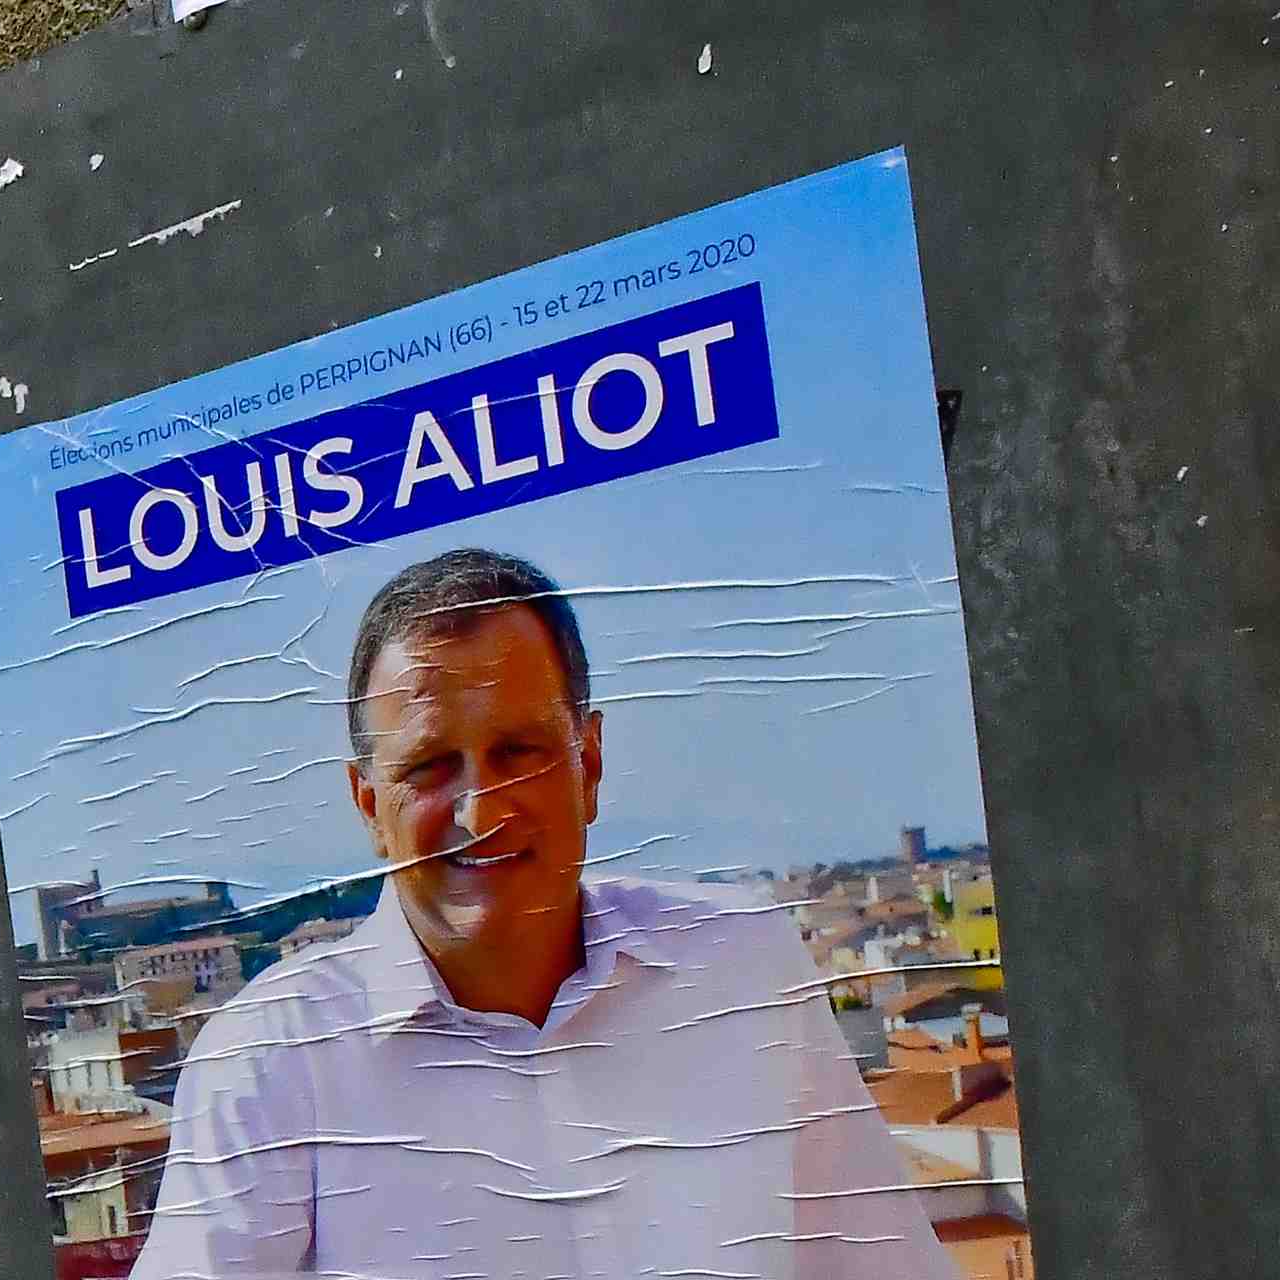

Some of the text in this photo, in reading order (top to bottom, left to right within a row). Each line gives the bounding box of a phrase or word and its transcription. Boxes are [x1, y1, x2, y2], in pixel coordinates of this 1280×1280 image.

[77, 320, 736, 591] LOUIS ALIOT
[138, 397, 263, 448] municipales
[266, 380, 295, 406] de
[299, 332, 443, 396] PERPIGNAN
[450, 314, 493, 352] (66)
[513, 301, 539, 327] 15
[544, 292, 571, 319] et
[575, 280, 608, 310] 22
[613, 260, 682, 297] mars
[687, 232, 757, 274] 2020
